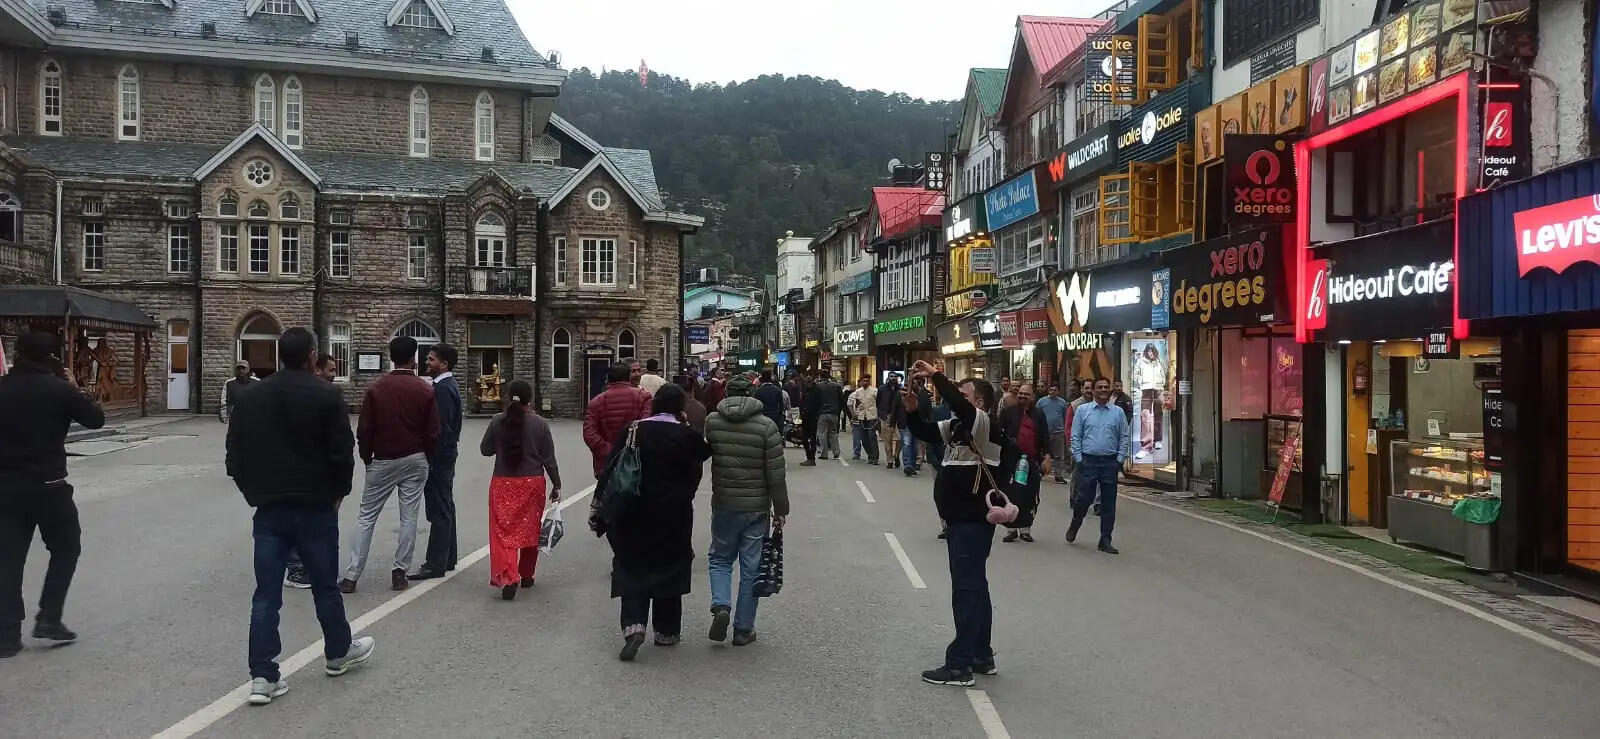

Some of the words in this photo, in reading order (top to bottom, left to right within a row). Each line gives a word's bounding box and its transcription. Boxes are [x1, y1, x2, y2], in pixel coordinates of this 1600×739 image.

[1093, 80, 1130, 93] bae
[1118, 127, 1141, 149] wake
[1156, 106, 1182, 131] bake
[1067, 134, 1109, 170] WILDCRAFT
[1485, 166, 1509, 177] Café
[1234, 187, 1292, 204] xero
[1234, 201, 1292, 217] degrees
[1211, 240, 1265, 278] xero
[1328, 268, 1395, 305] Hideout
[1397, 259, 1455, 297] Café
[1173, 276, 1265, 324] degrees
[1024, 320, 1048, 329] SHREE
[837, 328, 865, 344] OCTAVE
[1056, 332, 1104, 351] WILDCRAFT
